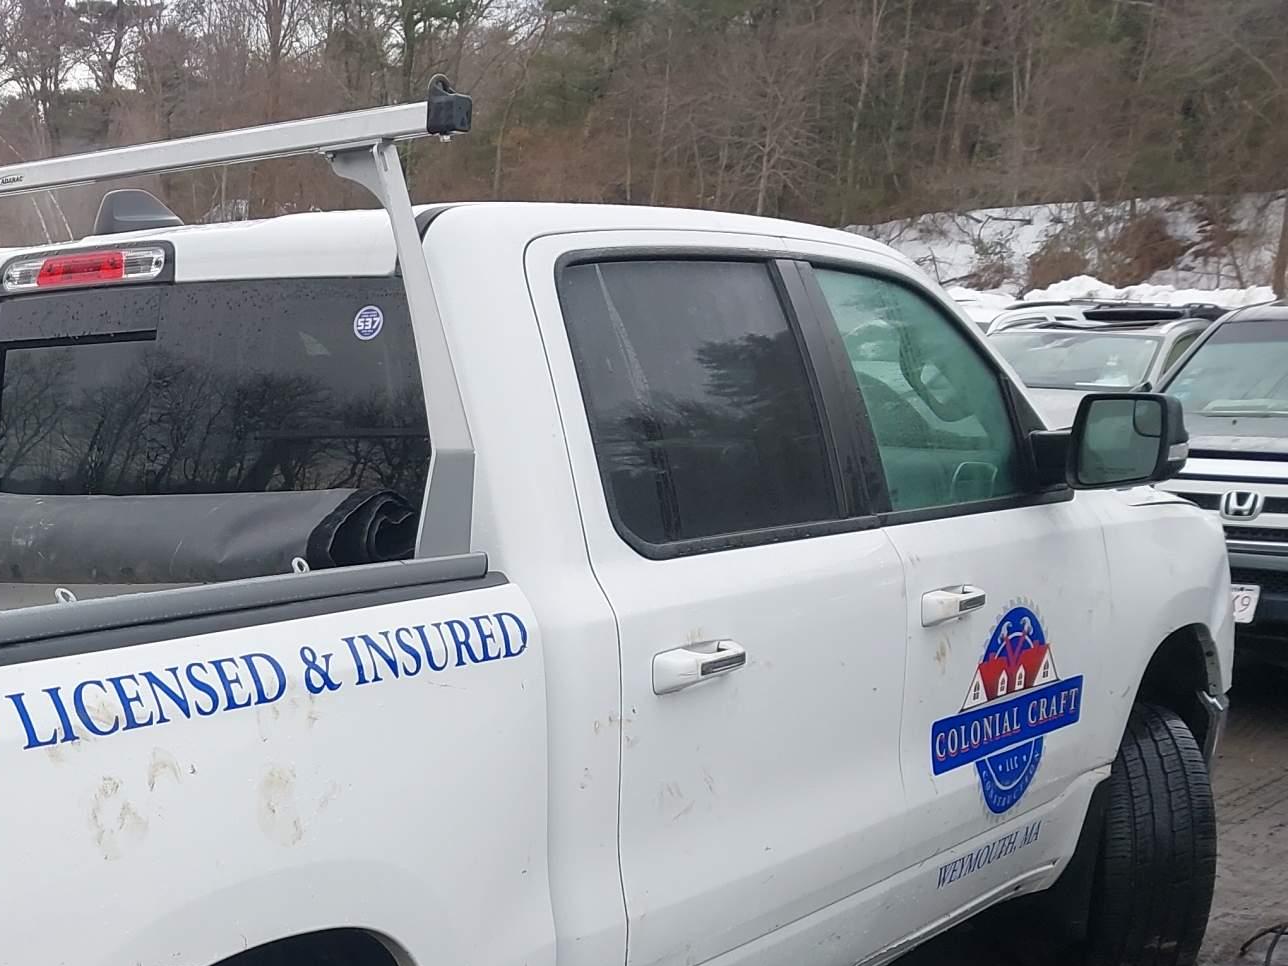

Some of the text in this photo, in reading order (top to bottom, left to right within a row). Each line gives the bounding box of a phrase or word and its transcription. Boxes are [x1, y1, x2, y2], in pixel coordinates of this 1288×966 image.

[357, 317, 380, 330] 537
[5, 652, 287, 751] LICENSED
[304, 646, 344, 694] &
[341, 612, 528, 686] INSURED
[936, 688, 1079, 760] COLONIAL CRAFT
[1019, 820, 1042, 849] MA
